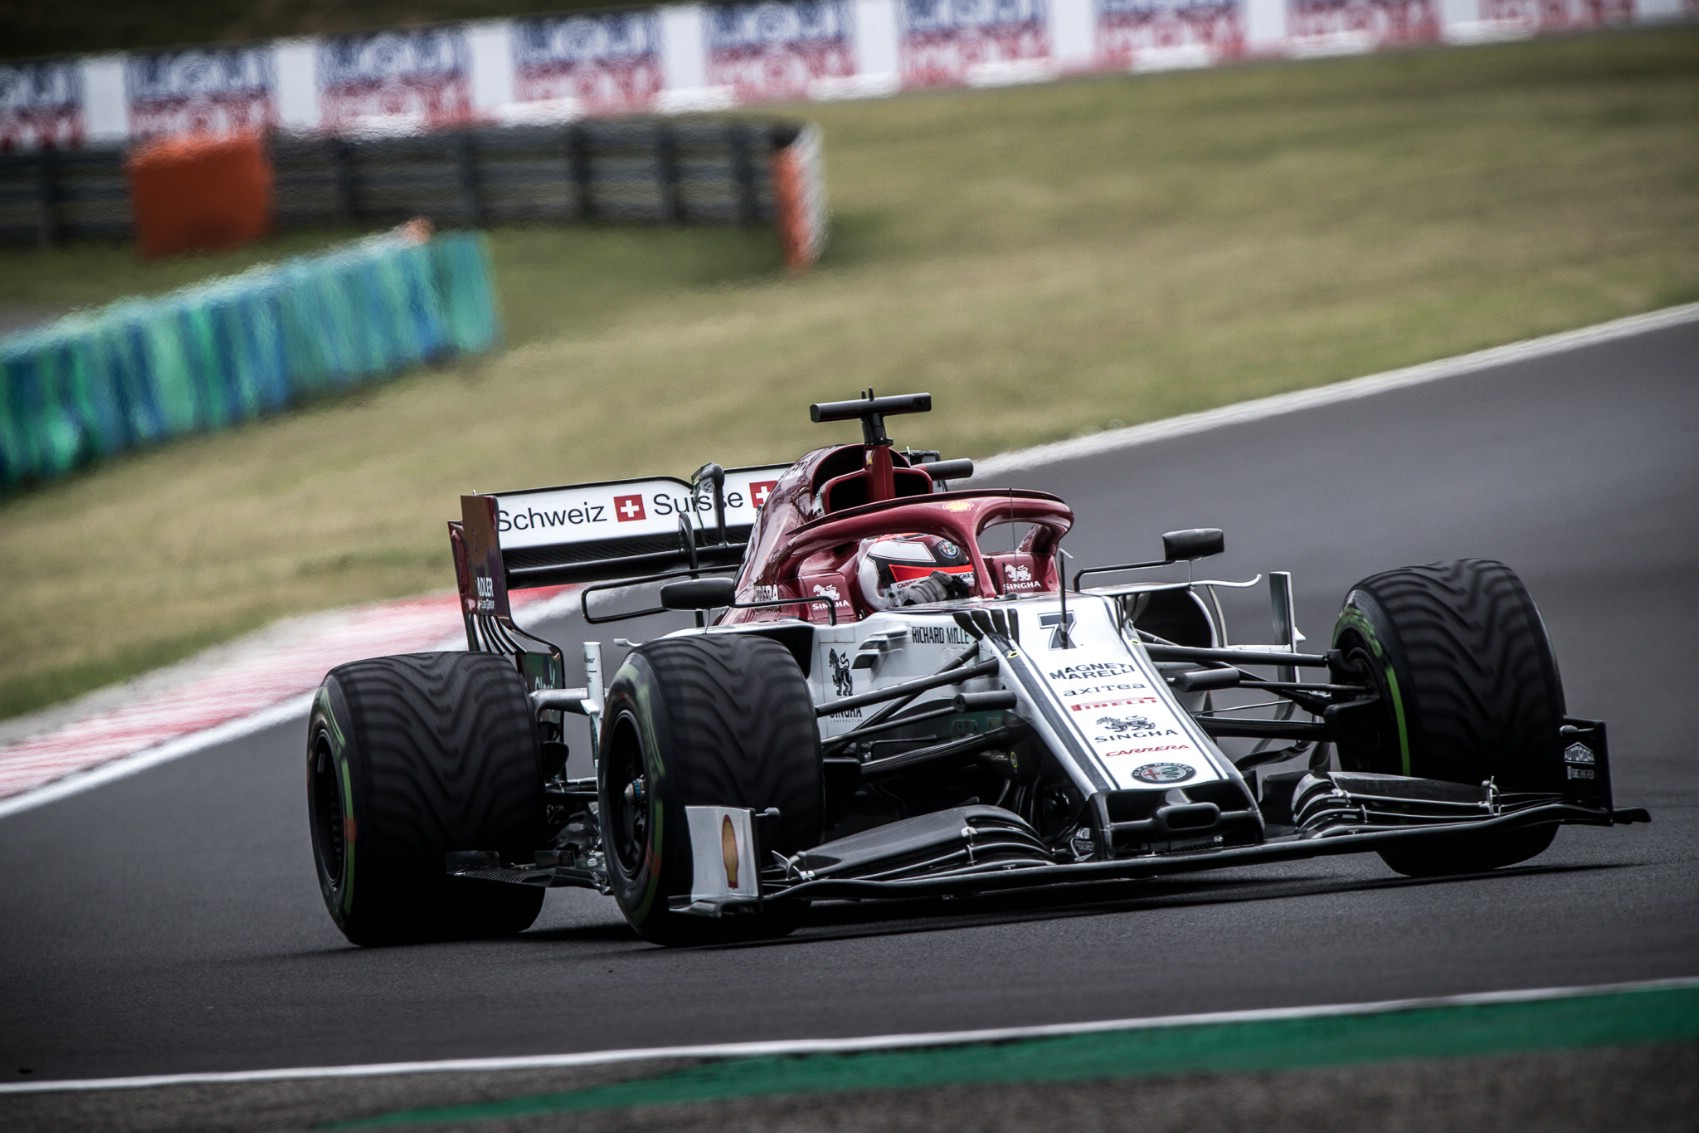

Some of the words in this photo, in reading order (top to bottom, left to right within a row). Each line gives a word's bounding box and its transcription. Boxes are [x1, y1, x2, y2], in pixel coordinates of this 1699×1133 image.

[653, 491, 744, 516] Suise
[498, 501, 608, 532] Schweiz
[1003, 580, 1041, 591] SINGHA
[812, 600, 850, 611] SINHA
[911, 626, 945, 644] RICHARD
[1037, 609, 1077, 652] 7
[1049, 664, 1136, 680] MARELLI
[1094, 729, 1179, 743] SINGHA
[1105, 744, 1190, 758] CARRERA
